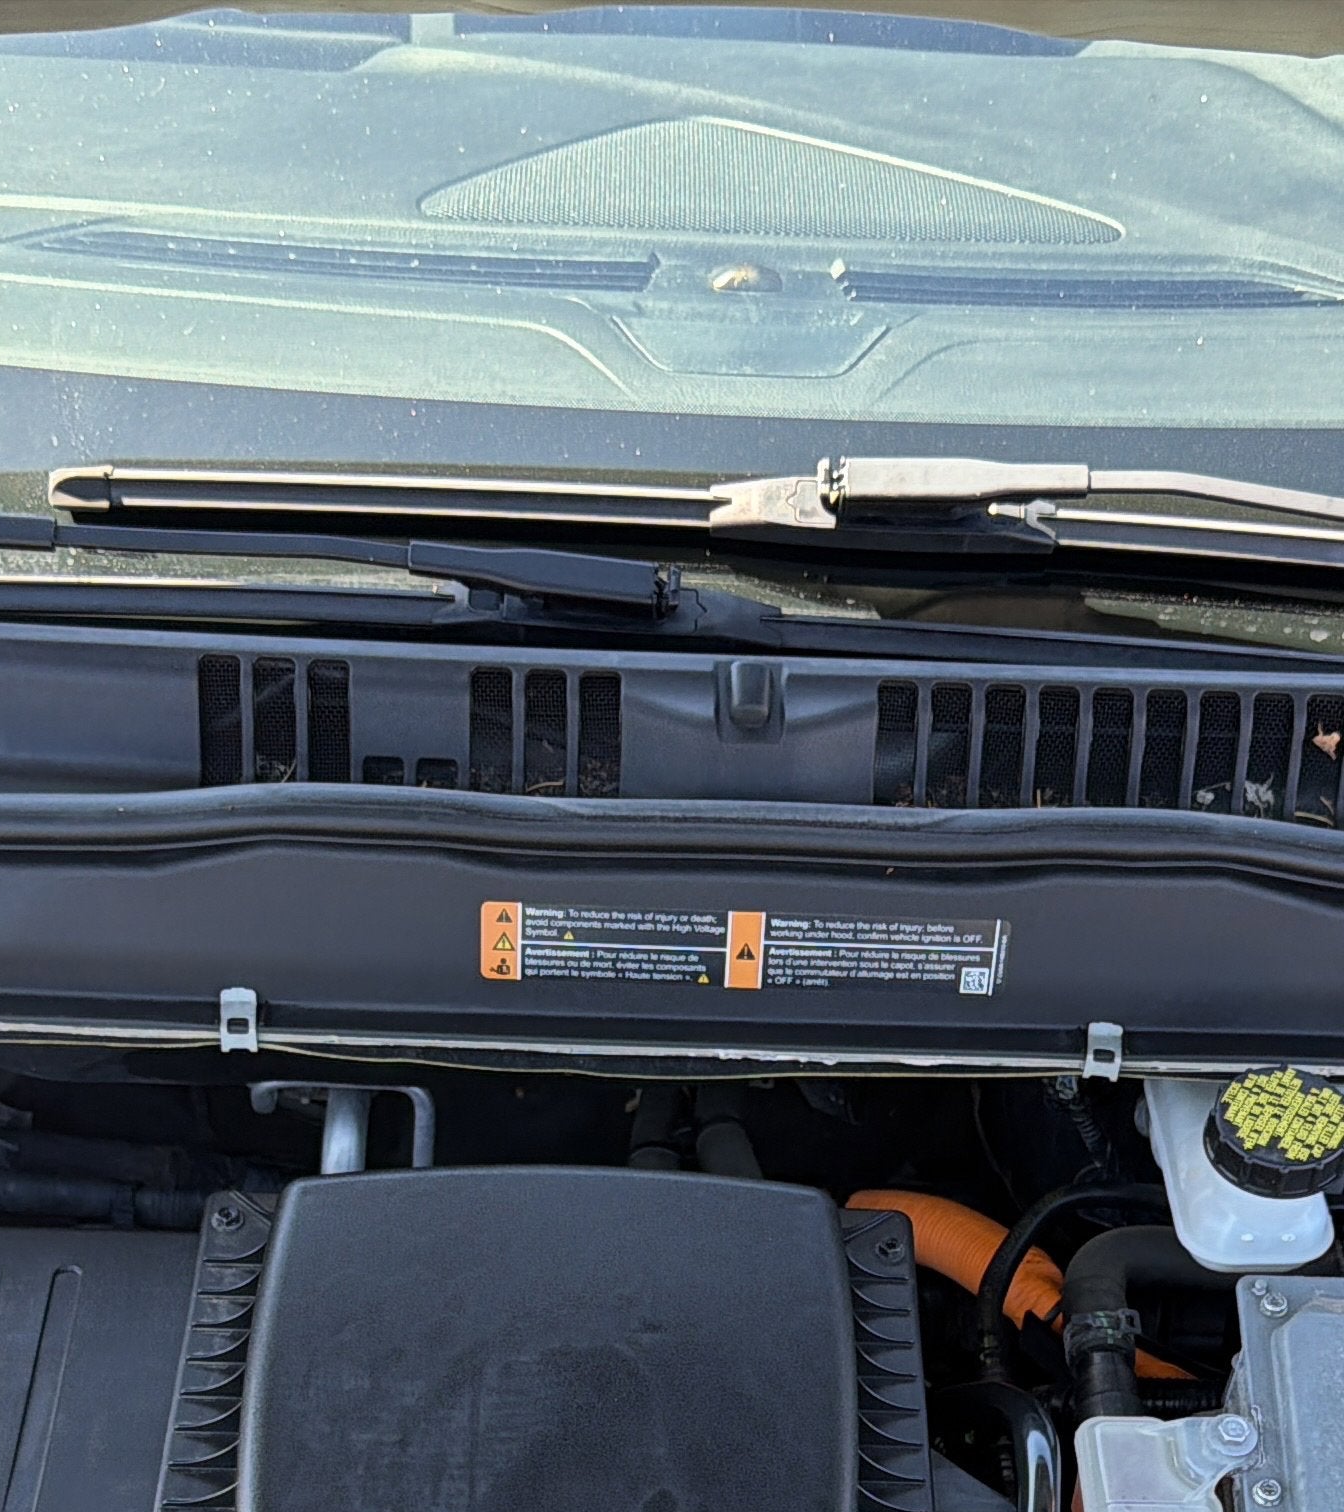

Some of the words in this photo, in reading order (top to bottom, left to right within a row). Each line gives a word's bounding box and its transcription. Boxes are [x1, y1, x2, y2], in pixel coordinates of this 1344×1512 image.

[568, 909, 578, 917] To
[581, 911, 610, 919] reduce
[611, 911, 625, 920] the
[627, 912, 642, 920] risk
[644, 912, 653, 920] of
[655, 913, 678, 923] injury
[550, 920, 601, 929] components
[604, 922, 635, 930] marked
[637, 922, 655, 931] with
[656, 923, 670, 931] the
[672, 924, 692, 934] High
[694, 925, 725, 936] Voltage
[771, 919, 811, 930] Warning:
[814, 920, 824, 928] To
[826, 921, 855, 930] reduce
[856, 921, 870, 930] the
[872, 922, 887, 931] risk
[889, 922, 898, 931] of
[927, 924, 954, 933] before
[770, 930, 803, 939] working
[805, 931, 829, 939] under
[857, 932, 888, 940] confirm
[890, 934, 920, 942] vehicle
[921, 935, 952, 944] ignition
[963, 935, 983, 944] OFF.
[596, 950, 616, 958] Pour
[660, 953, 686, 962] risque
[688, 954, 699, 962] de
[839, 949, 860, 958] Pour
[901, 952, 926, 961] risque
[941, 953, 980, 962] blessures
[810, 959, 857, 967] intervention
[625, 971, 650, 980] Haute
[652, 972, 683, 980] tension
[775, 976, 793, 985] OFF
[795, 969, 848, 977] commutateur
[923, 972, 955, 981] position
